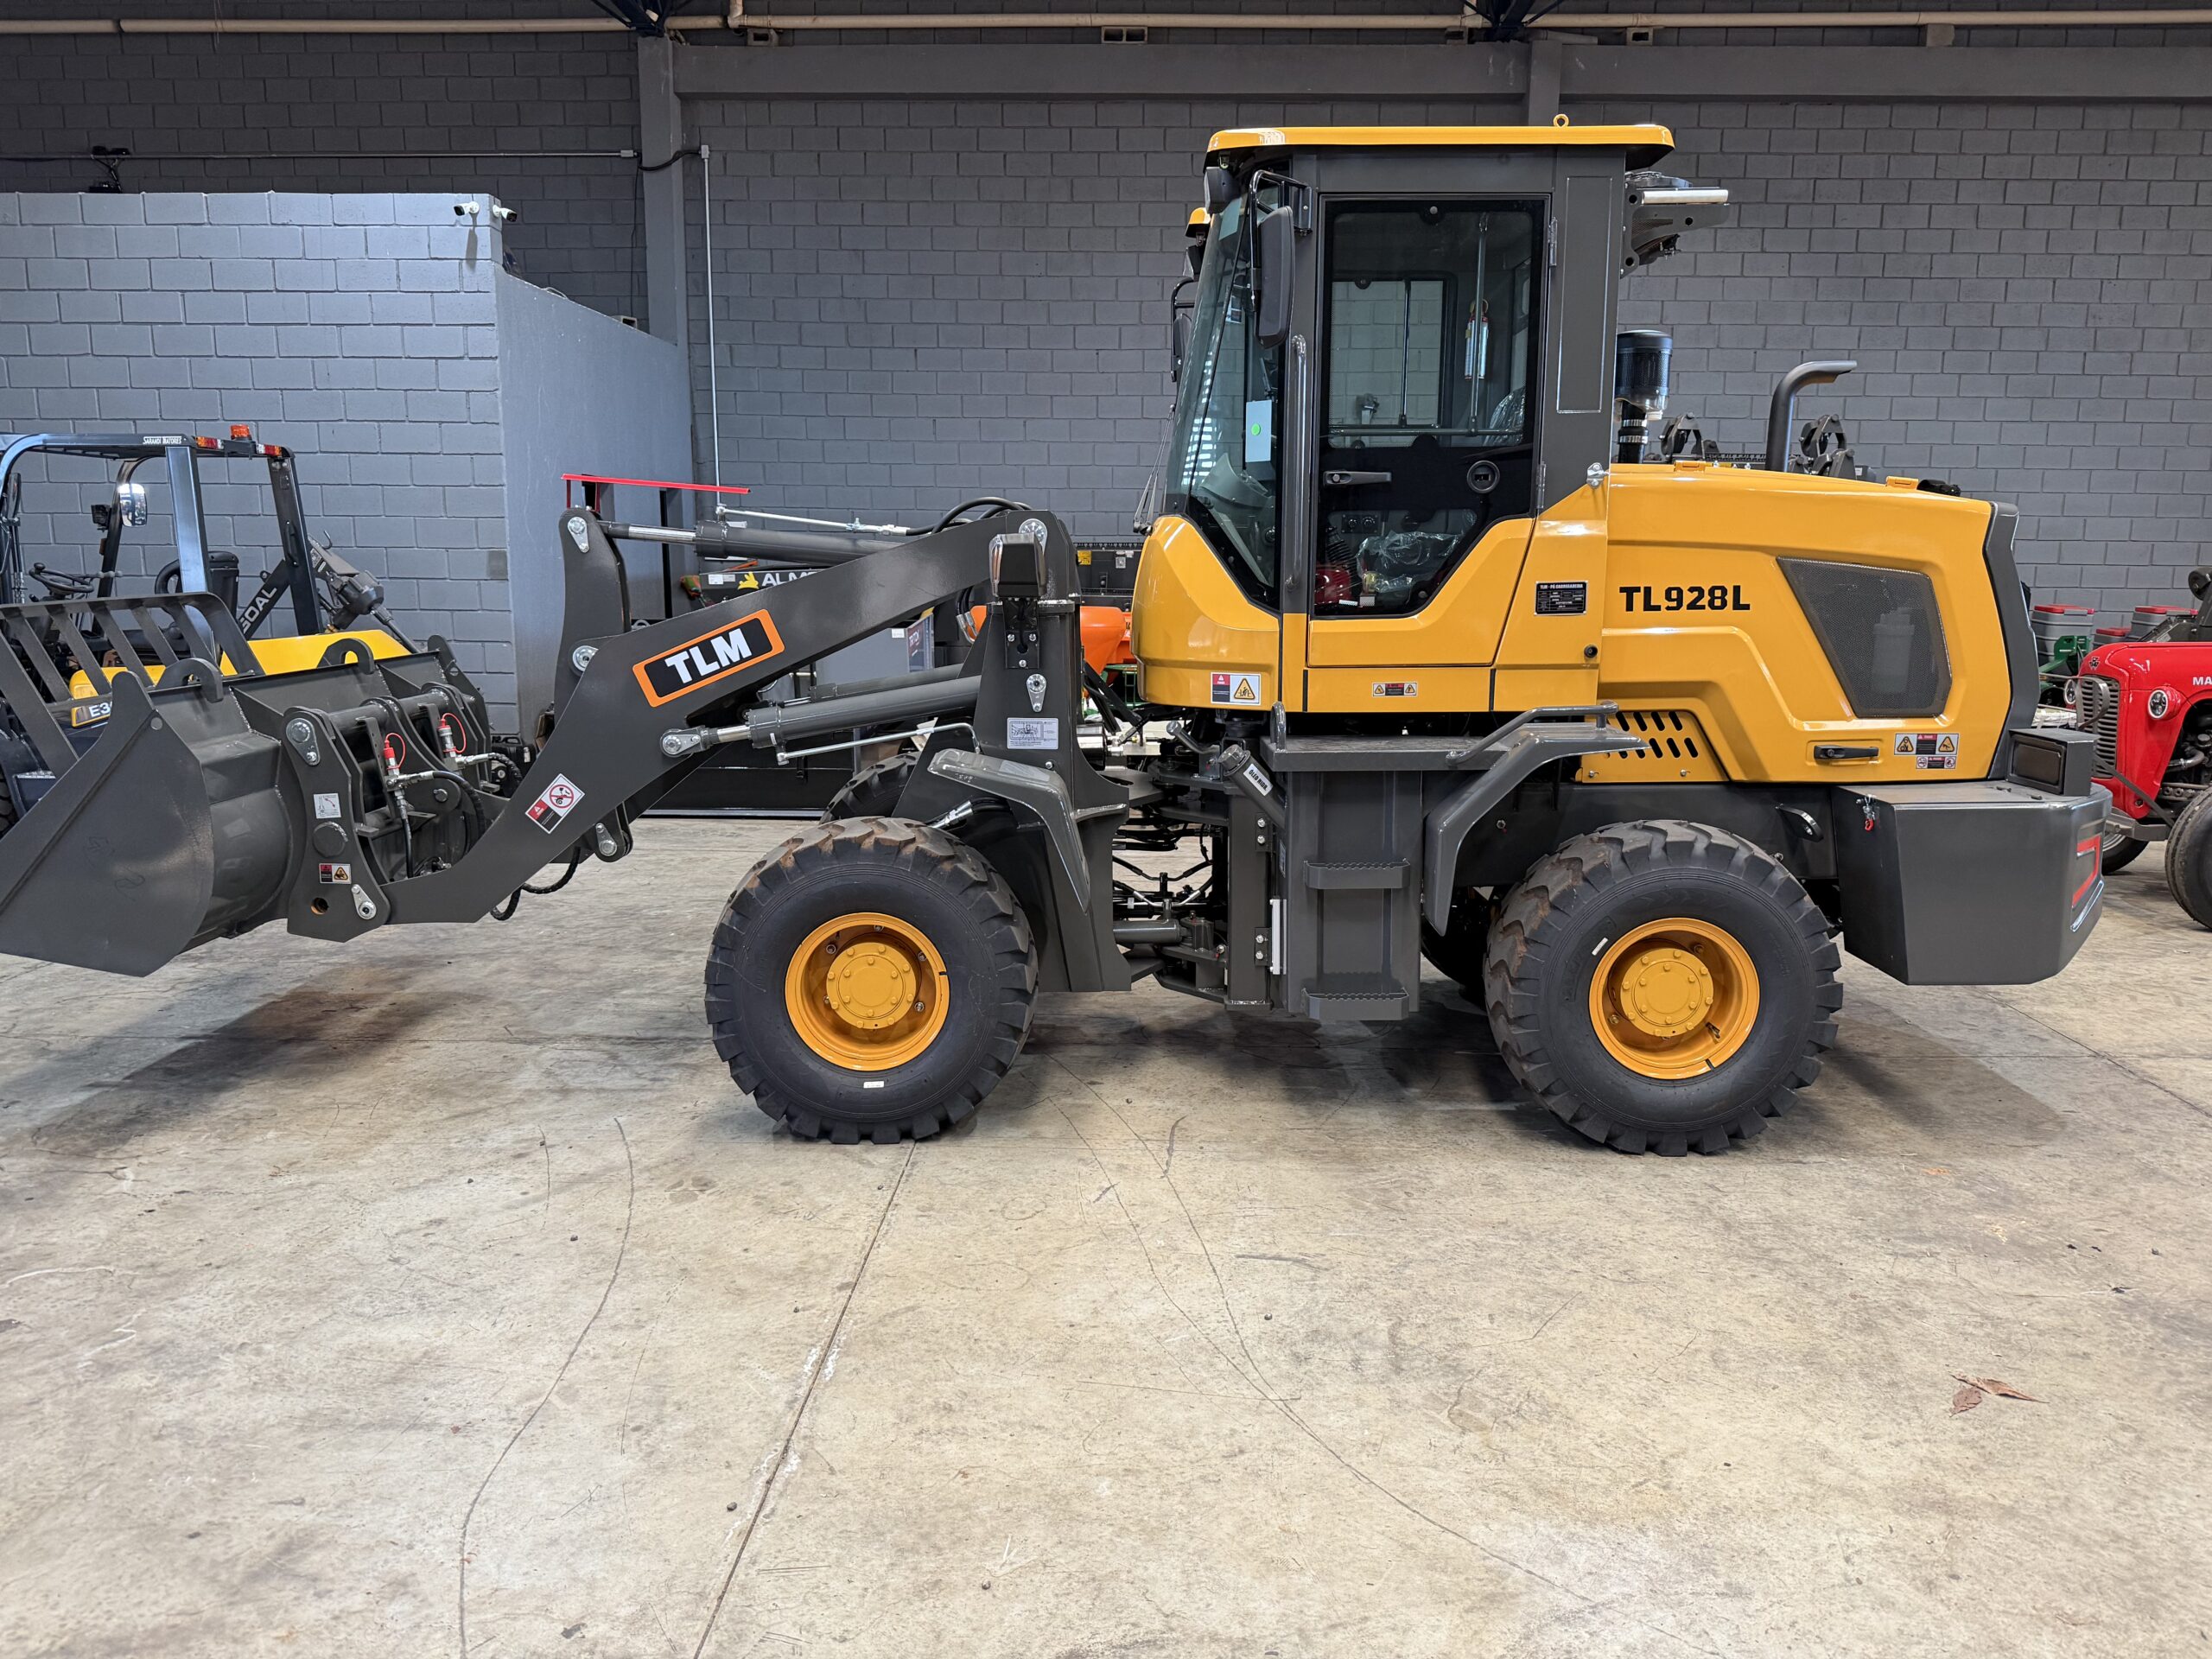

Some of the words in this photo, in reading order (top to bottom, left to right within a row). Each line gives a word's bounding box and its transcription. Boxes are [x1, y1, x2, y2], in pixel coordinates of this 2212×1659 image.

[1619, 585, 1751, 612] TL928L
[664, 628, 752, 684] TLM
[89, 701, 112, 718] E3
